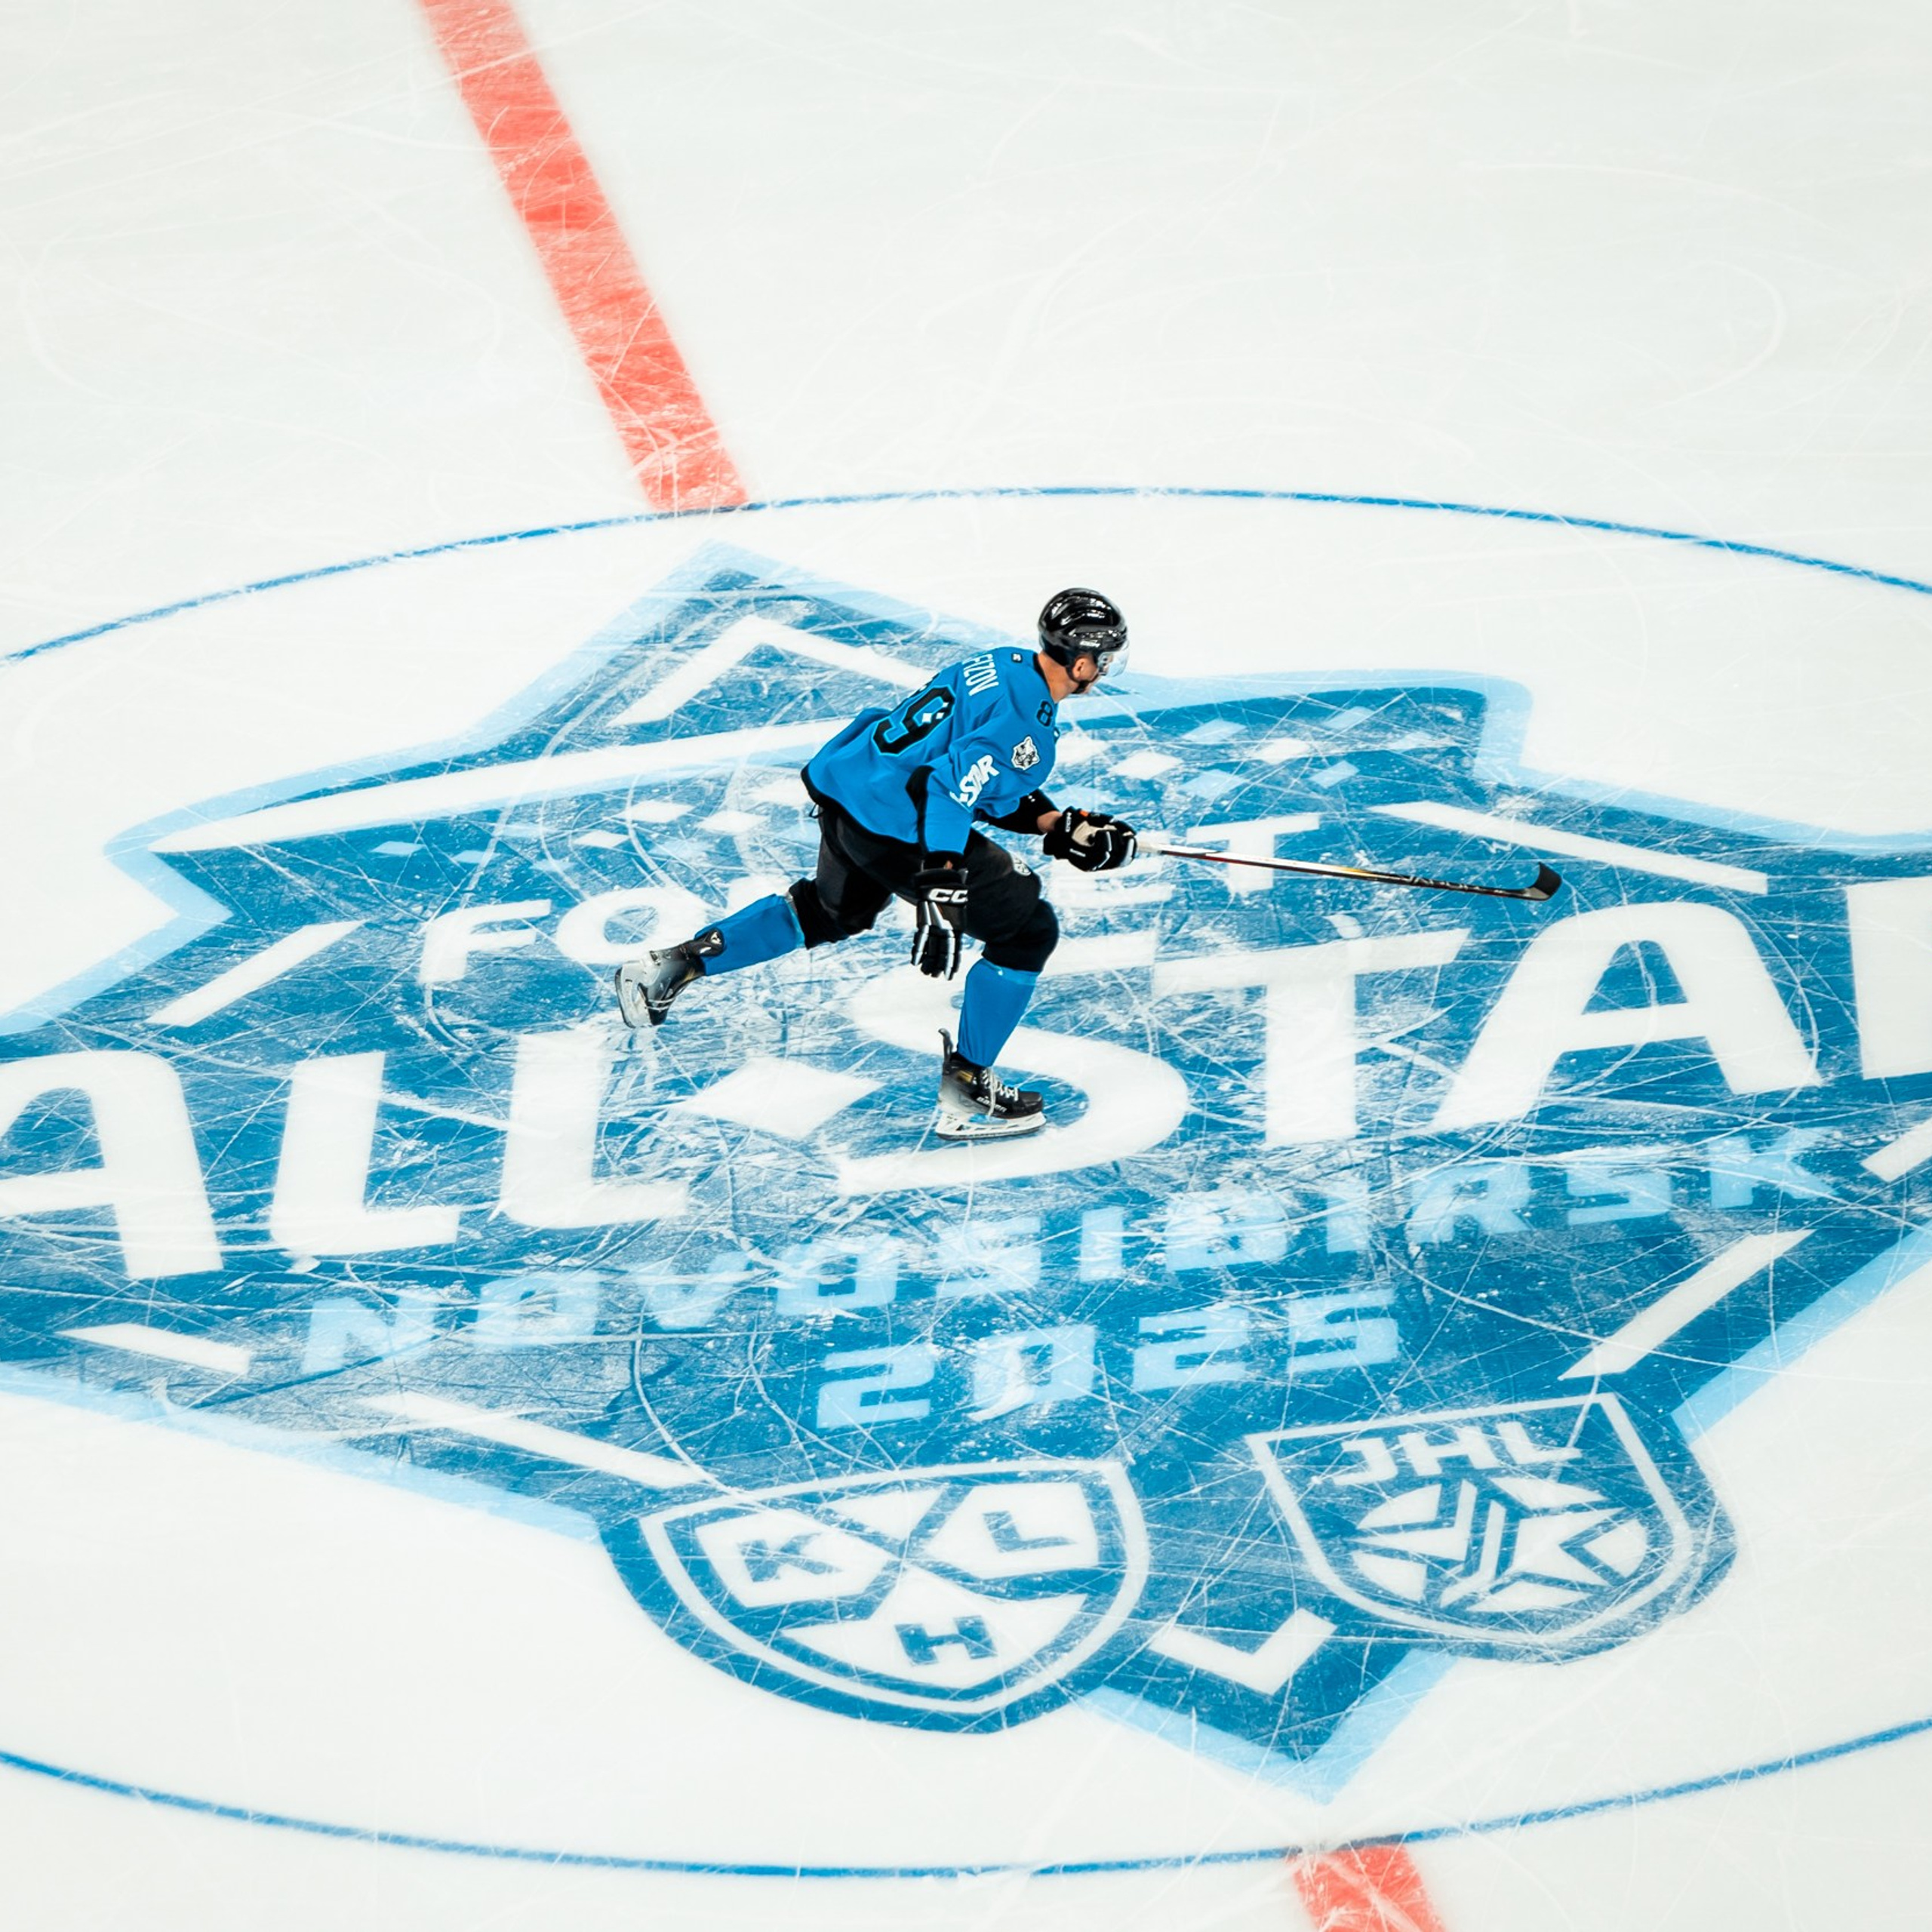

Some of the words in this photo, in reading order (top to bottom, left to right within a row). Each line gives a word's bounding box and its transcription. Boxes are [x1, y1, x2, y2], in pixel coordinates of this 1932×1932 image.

[871, 679, 956, 757] 9
[962, 654, 999, 696] FIZOV
[419, 813, 1319, 984] FOET
[302, 1126, 1839, 1376] NOVOSIBIRSK
[817, 1285, 1400, 1429] 2025
[1317, 1420, 1583, 1487] JHL
